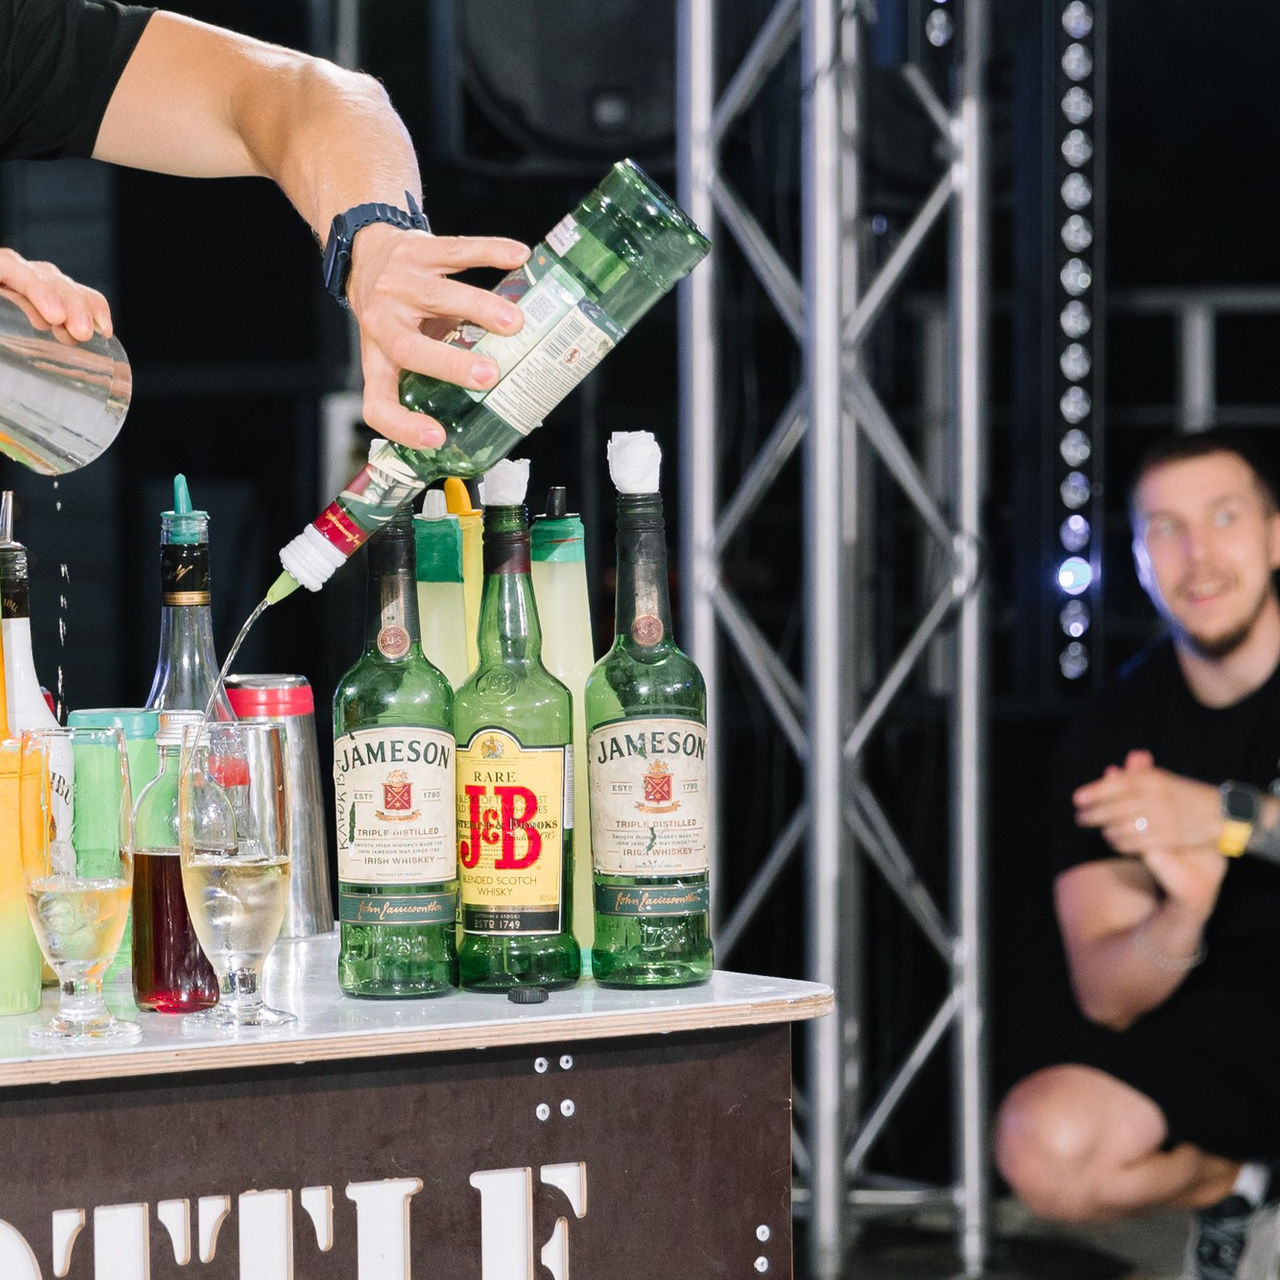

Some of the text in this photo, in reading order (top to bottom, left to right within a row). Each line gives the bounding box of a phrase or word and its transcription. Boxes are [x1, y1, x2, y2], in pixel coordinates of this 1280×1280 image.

[598, 731, 706, 764] JAMESON
[341, 740, 451, 773] JAMESON
[473, 771, 517, 783] RARE
[682, 783, 698, 791] 1780
[423, 791, 441, 799] 1780
[481, 795, 494, 805] OF
[461, 785, 541, 870] J&B
[494, 818, 504, 830] &
[615, 818, 697, 829] TRIPLE DISTILLED
[358, 827, 440, 837] TRIPLE DISTILLED
[652, 847, 693, 856] WHISKEY
[364, 855, 435, 865] IRISH WHISKEY
[462, 874, 537, 886] BLENDED SCOTCH
[477, 887, 513, 897] WHISKY
[499, 920, 521, 930] 1749
